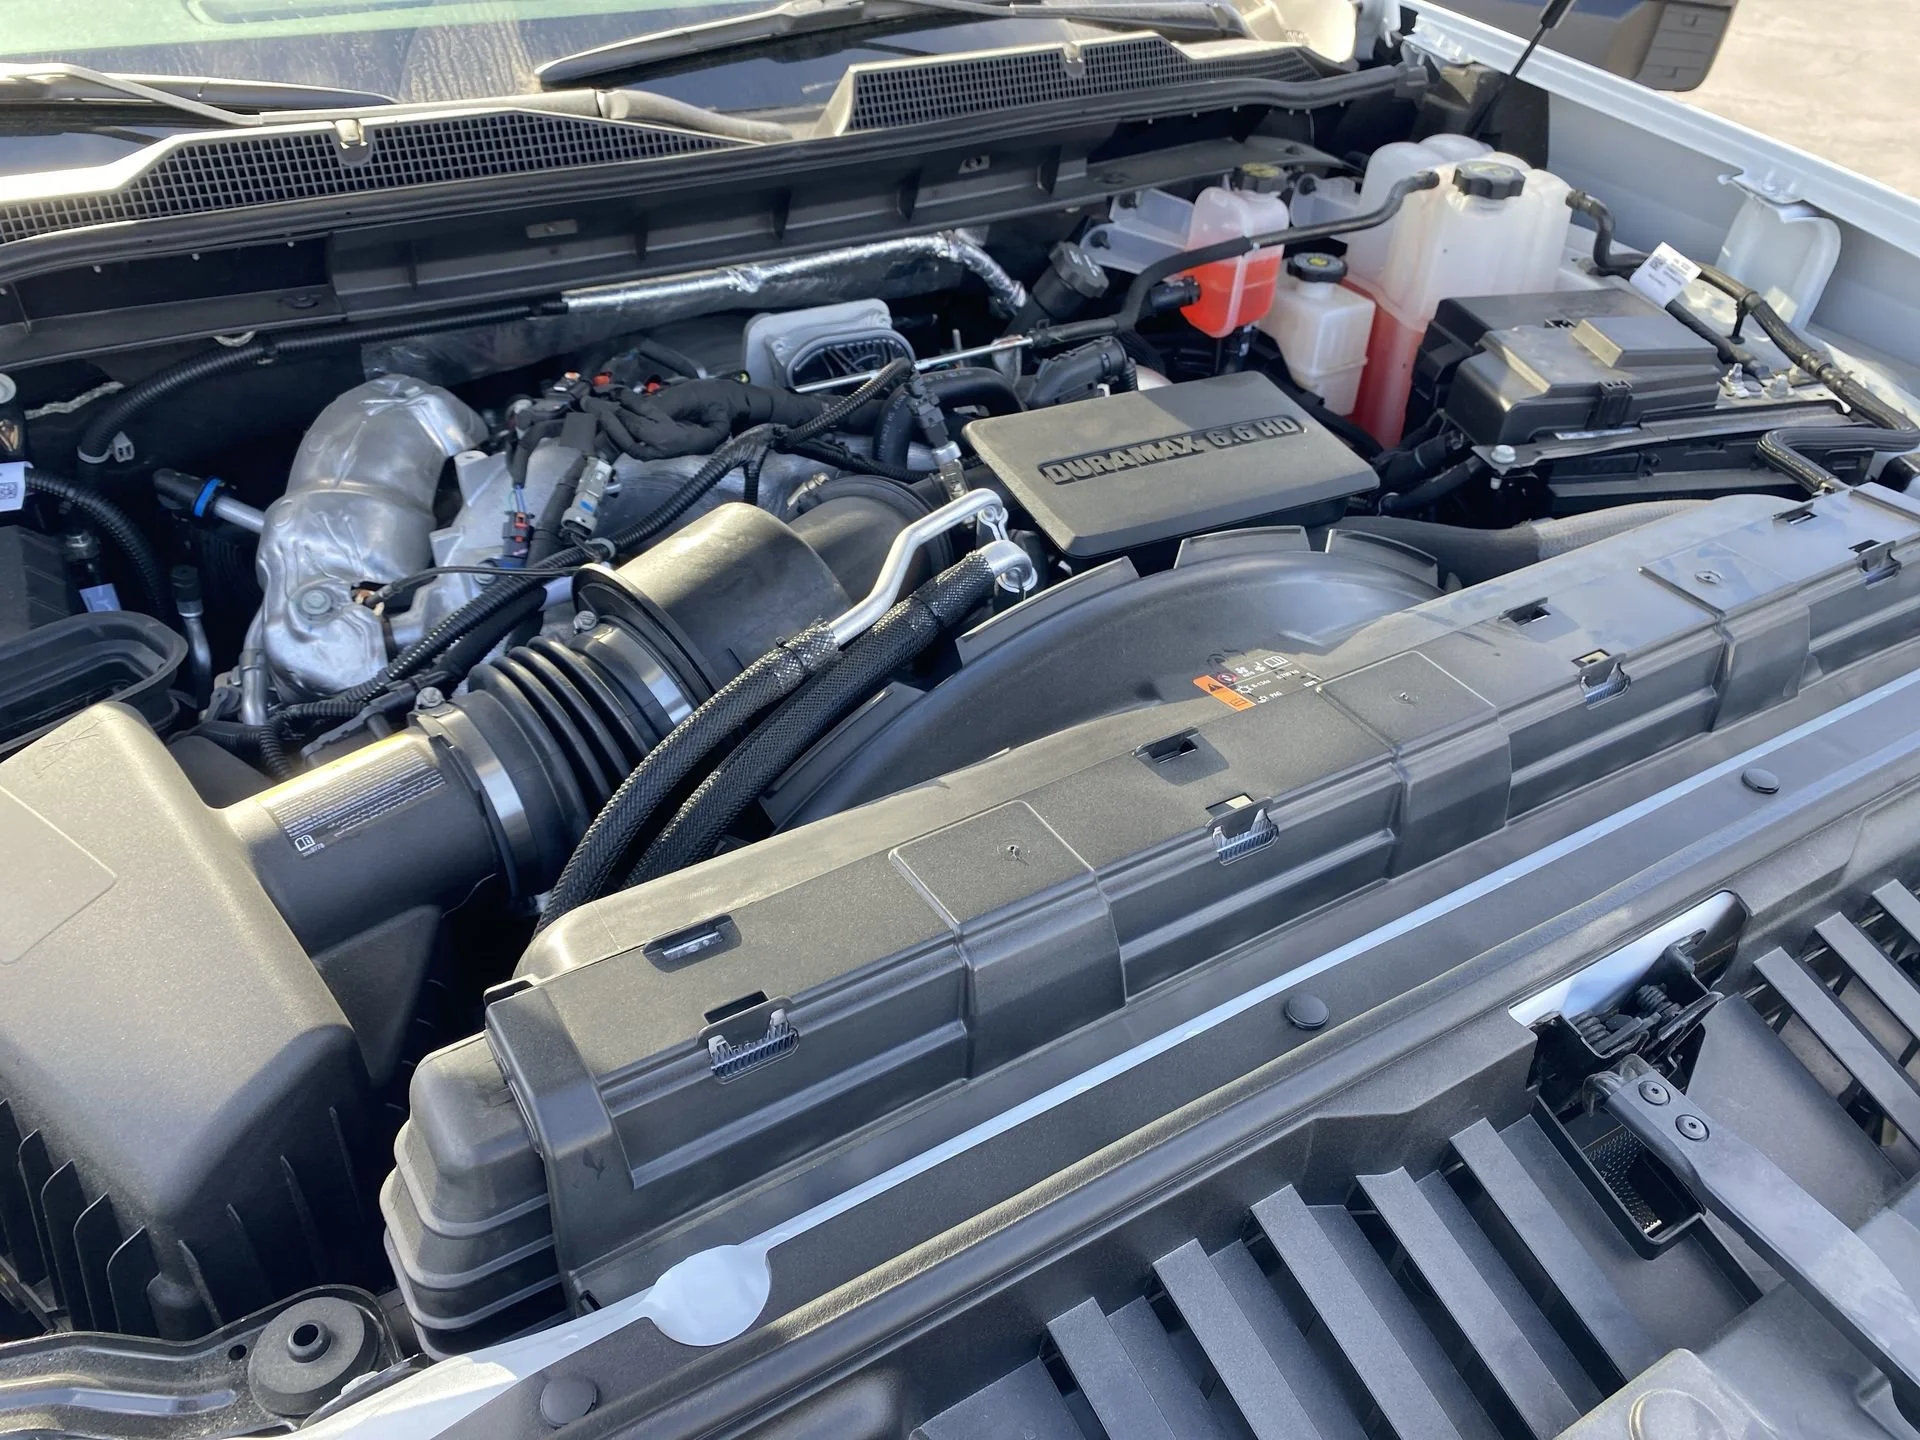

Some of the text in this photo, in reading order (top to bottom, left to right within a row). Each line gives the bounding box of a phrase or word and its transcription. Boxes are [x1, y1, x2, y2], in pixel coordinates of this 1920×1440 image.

[1043, 417, 1300, 484] DURAMAX 6.6 HD
